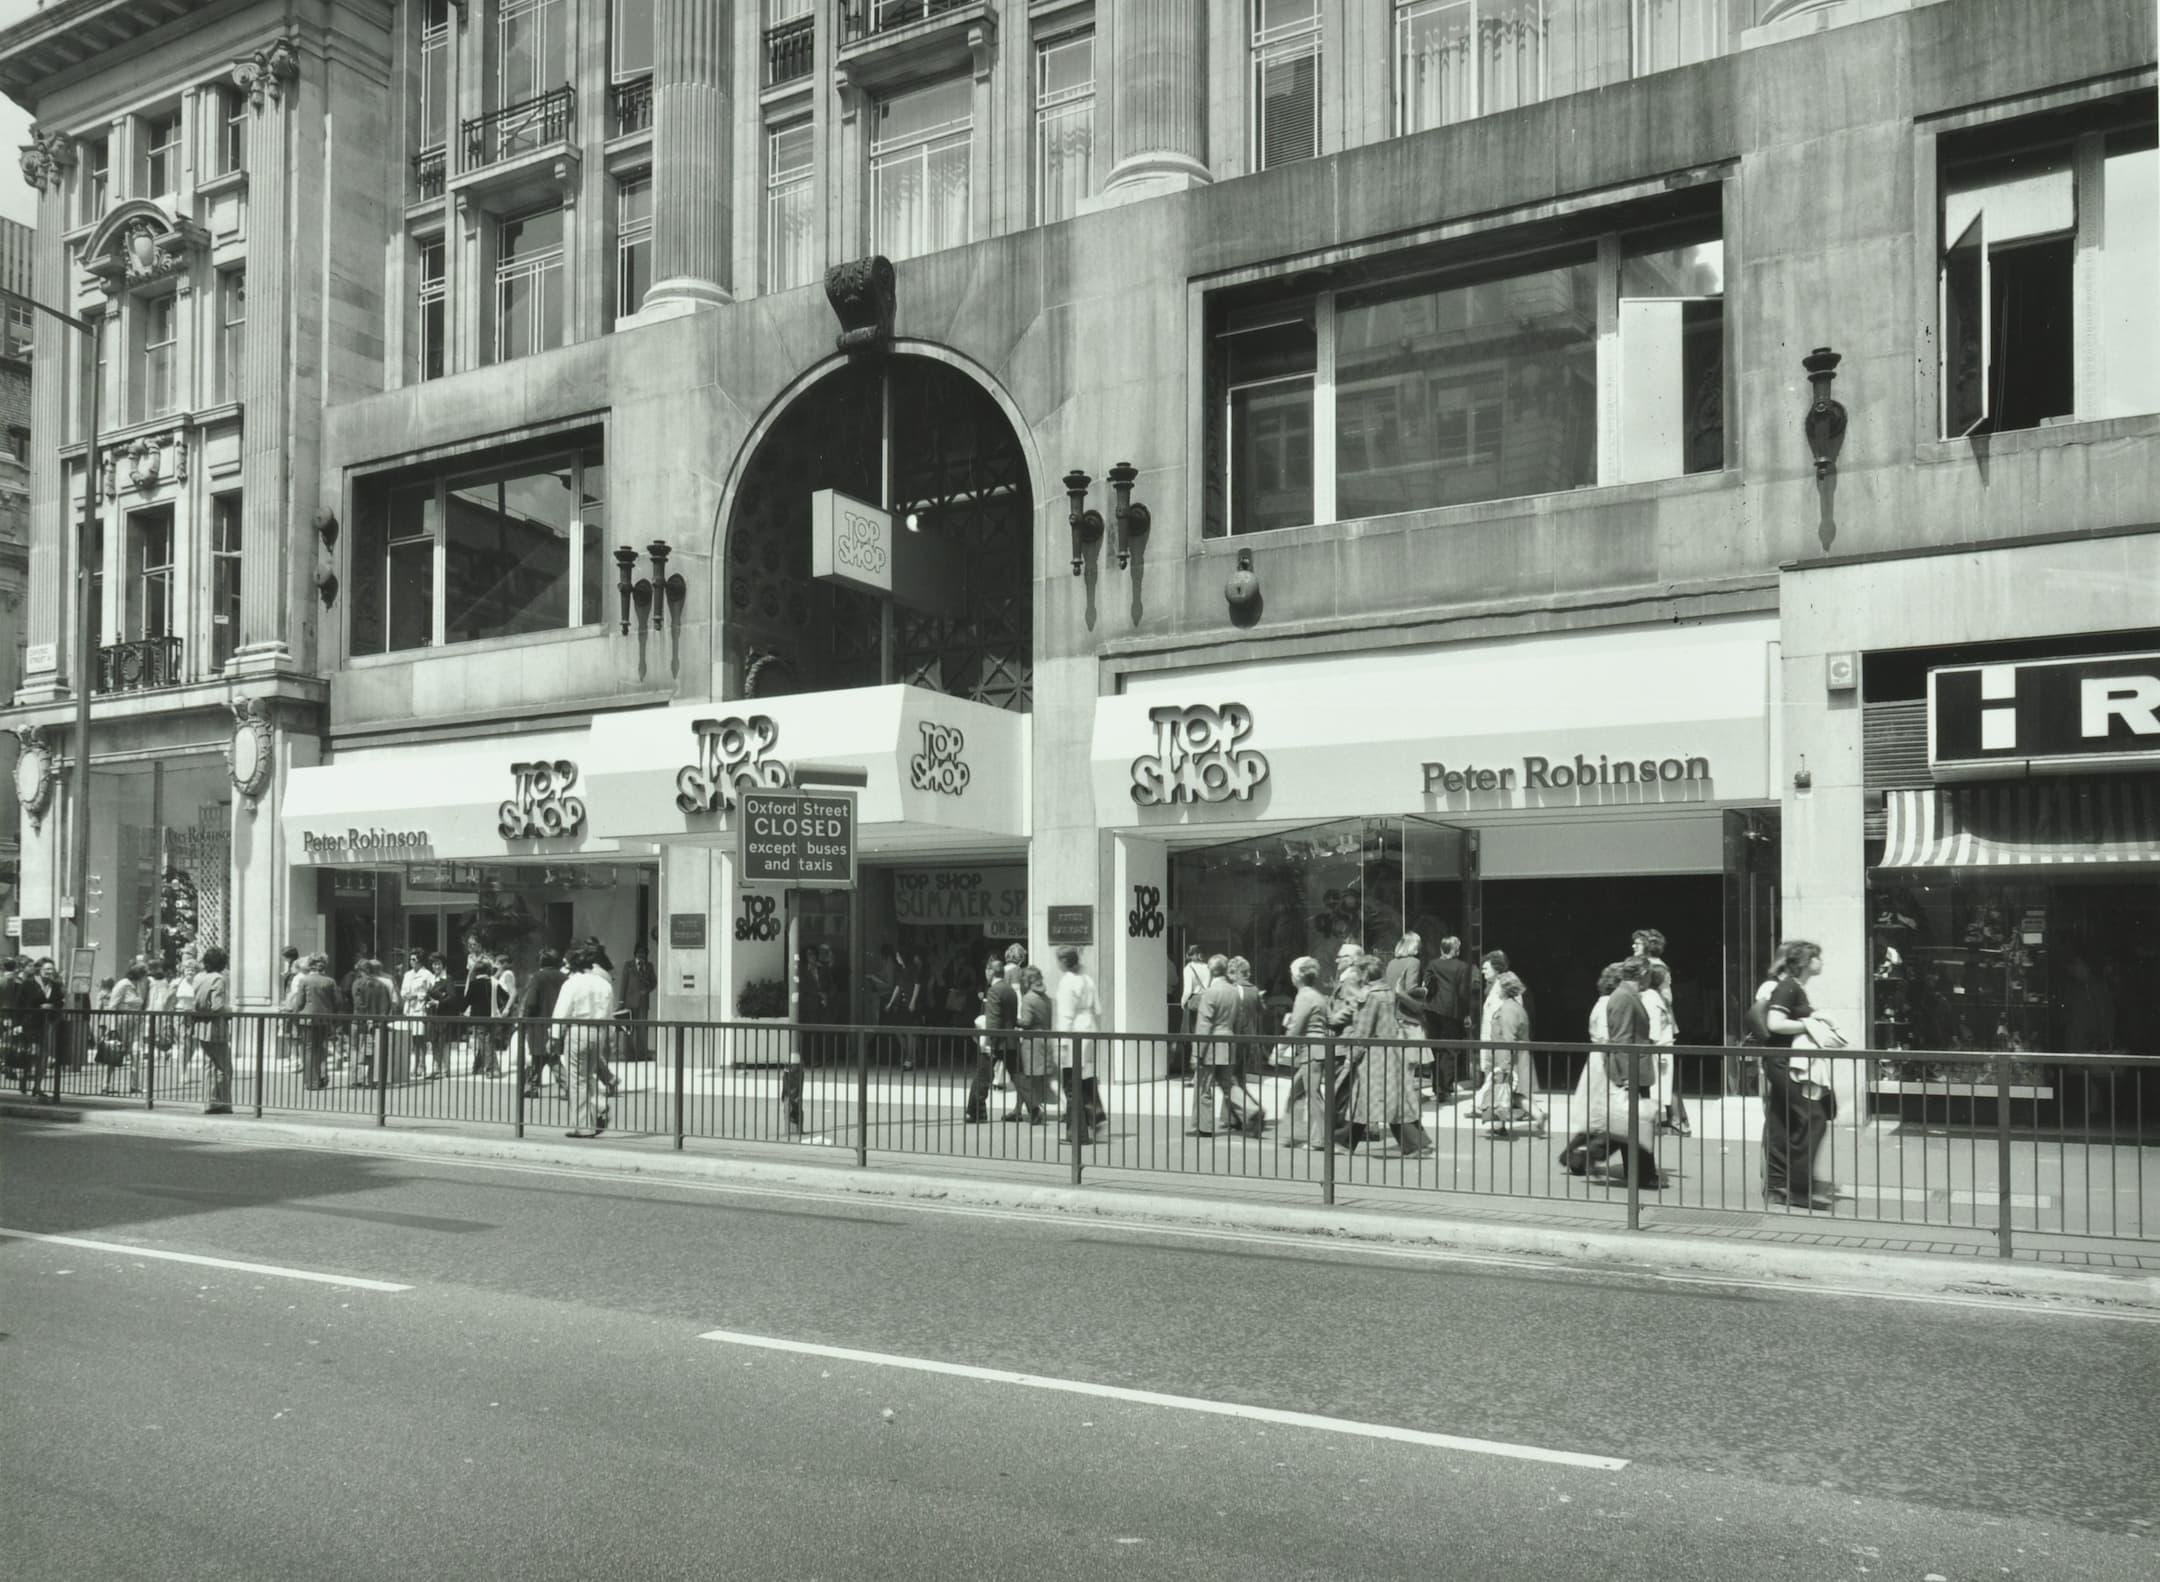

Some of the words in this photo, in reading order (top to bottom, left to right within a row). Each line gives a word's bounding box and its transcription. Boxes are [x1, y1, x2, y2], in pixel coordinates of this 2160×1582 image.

[845, 511, 880, 545] TOP
[838, 535, 886, 574] SHOP
[692, 715, 779, 766] TOP
[919, 721, 964, 761] TOP
[1148, 703, 1253, 755] TOP
[511, 760, 578, 801] TOP
[911, 753, 970, 796] SHOP
[1130, 749, 1270, 807] SHOP
[1421, 762, 1514, 793] Peter
[1522, 754, 1709, 789] Robinson
[499, 796, 586, 840] SHOP
[747, 800, 796, 816] Oxford
[803, 802, 848, 817] Street
[303, 831, 344, 851] Peter
[348, 827, 429, 850] Robinson
[754, 817, 841, 837] CLOSED
[748, 842, 797, 855] except
[807, 841, 847, 855] buses
[764, 858, 790, 871] and
[799, 858, 833, 871] taxis
[896, 873, 928, 890] TOP
[935, 871, 982, 890] SHOP
[742, 895, 775, 919] TOP
[896, 890, 995, 918] SUMMER
[1134, 885, 1160, 912] TOP
[735, 917, 781, 941] SHOP
[1129, 910, 1164, 938] SHOP
